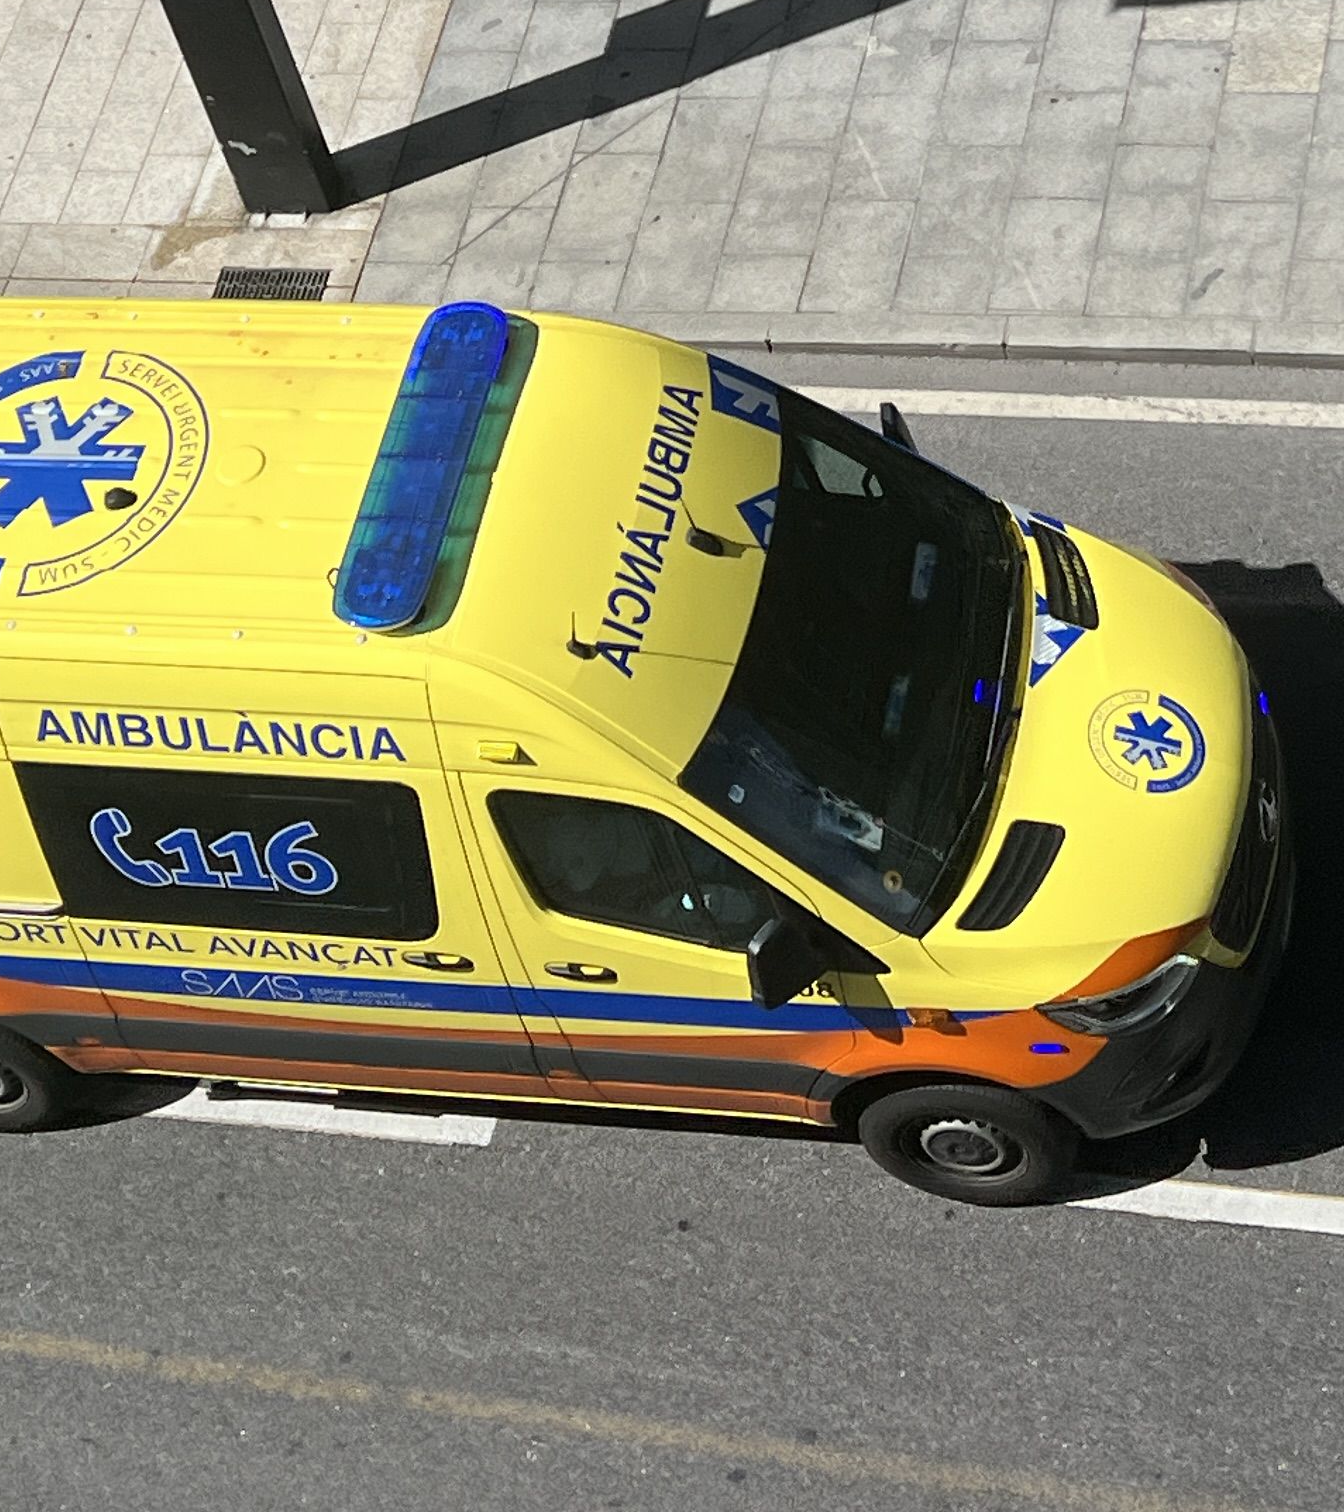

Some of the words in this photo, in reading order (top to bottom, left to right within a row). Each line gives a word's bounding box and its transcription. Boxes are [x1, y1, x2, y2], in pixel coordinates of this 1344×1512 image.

[118, 359, 182, 402] SERVEI
[173, 400, 199, 482] URGENT
[38, 555, 95, 585] SUM
[36, 707, 407, 762] AMBULÀNCIA
[156, 821, 338, 895] 116
[80, 926, 195, 953] VITAL
[209, 935, 397, 971] AVANÇAT
